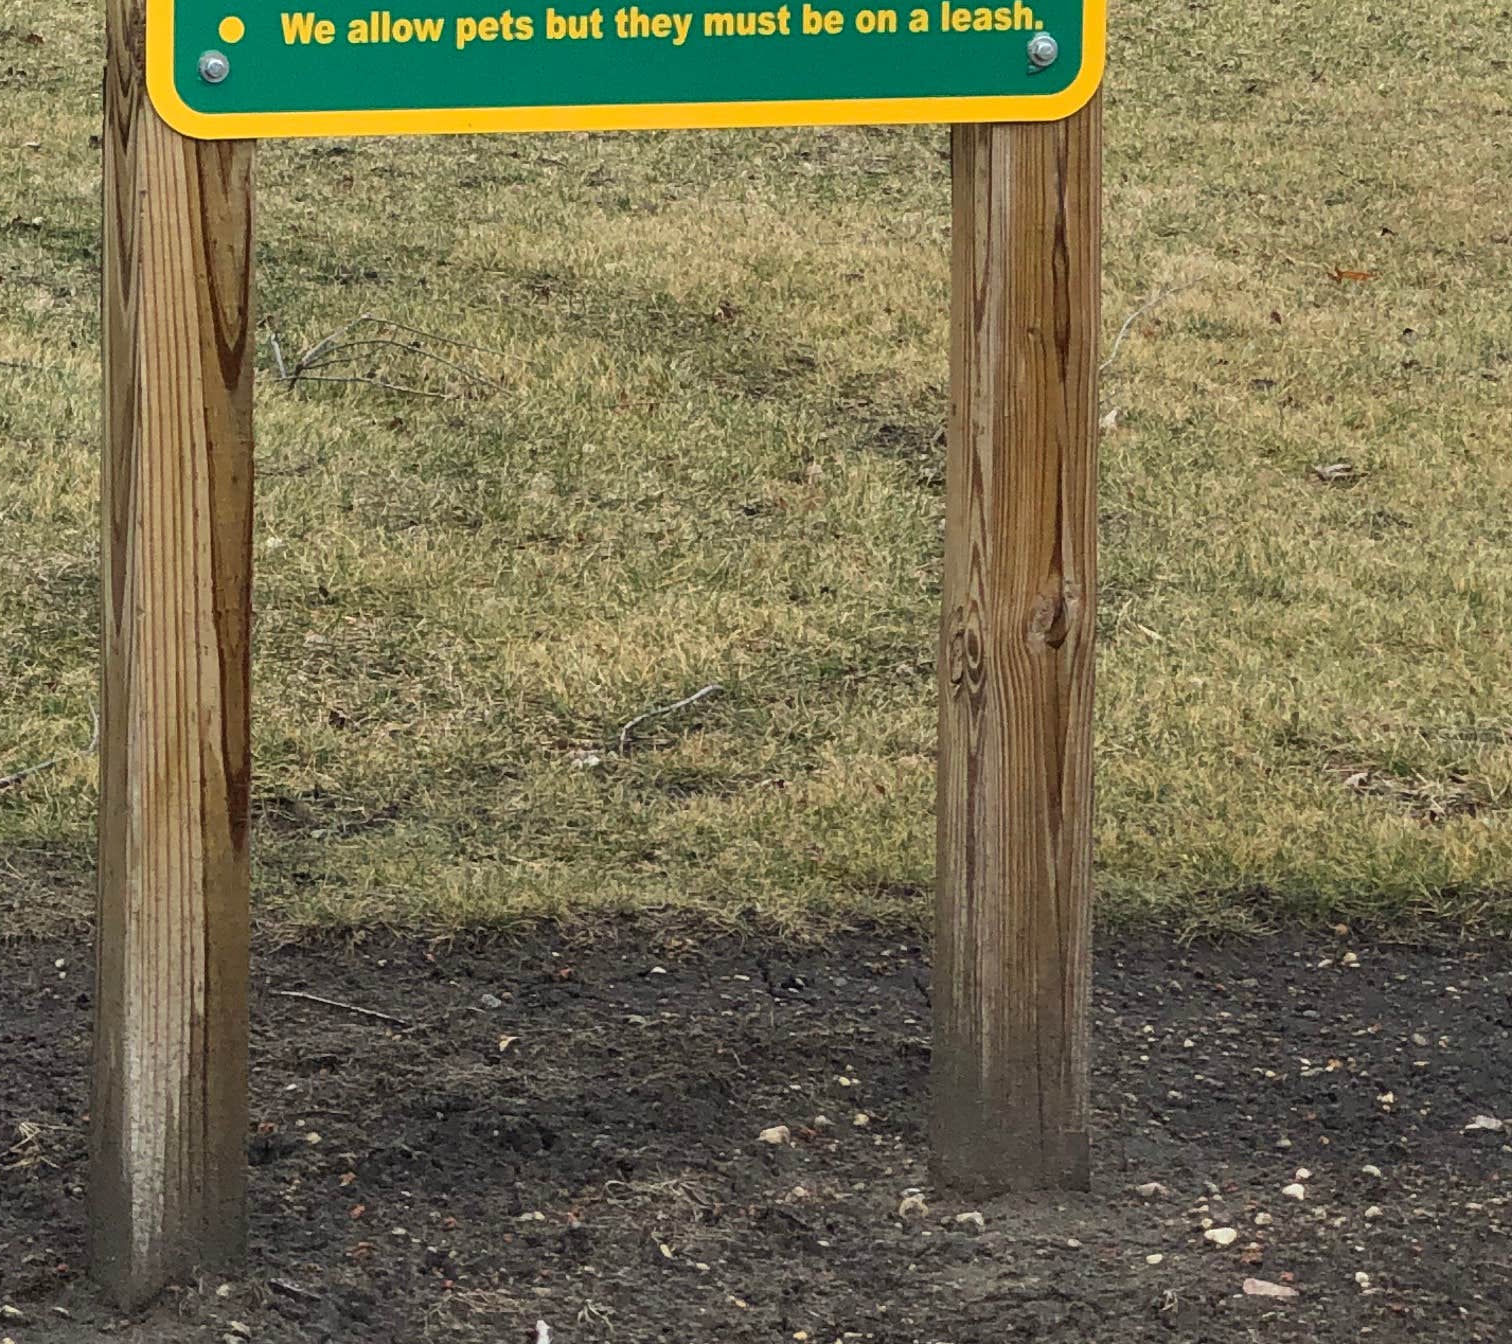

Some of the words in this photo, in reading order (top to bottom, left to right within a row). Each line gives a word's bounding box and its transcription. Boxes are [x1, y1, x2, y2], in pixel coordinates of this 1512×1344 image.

[282, 13, 335, 44] We
[348, 12, 444, 43] allow
[456, 12, 533, 48] pets
[546, 8, 602, 39] but
[615, 7, 691, 45] they
[704, 7, 790, 35] must
[802, 4, 843, 34] be
[856, 10, 897, 33] on
[909, 9, 929, 32] a
[941, 0, 1043, 31] leash.
